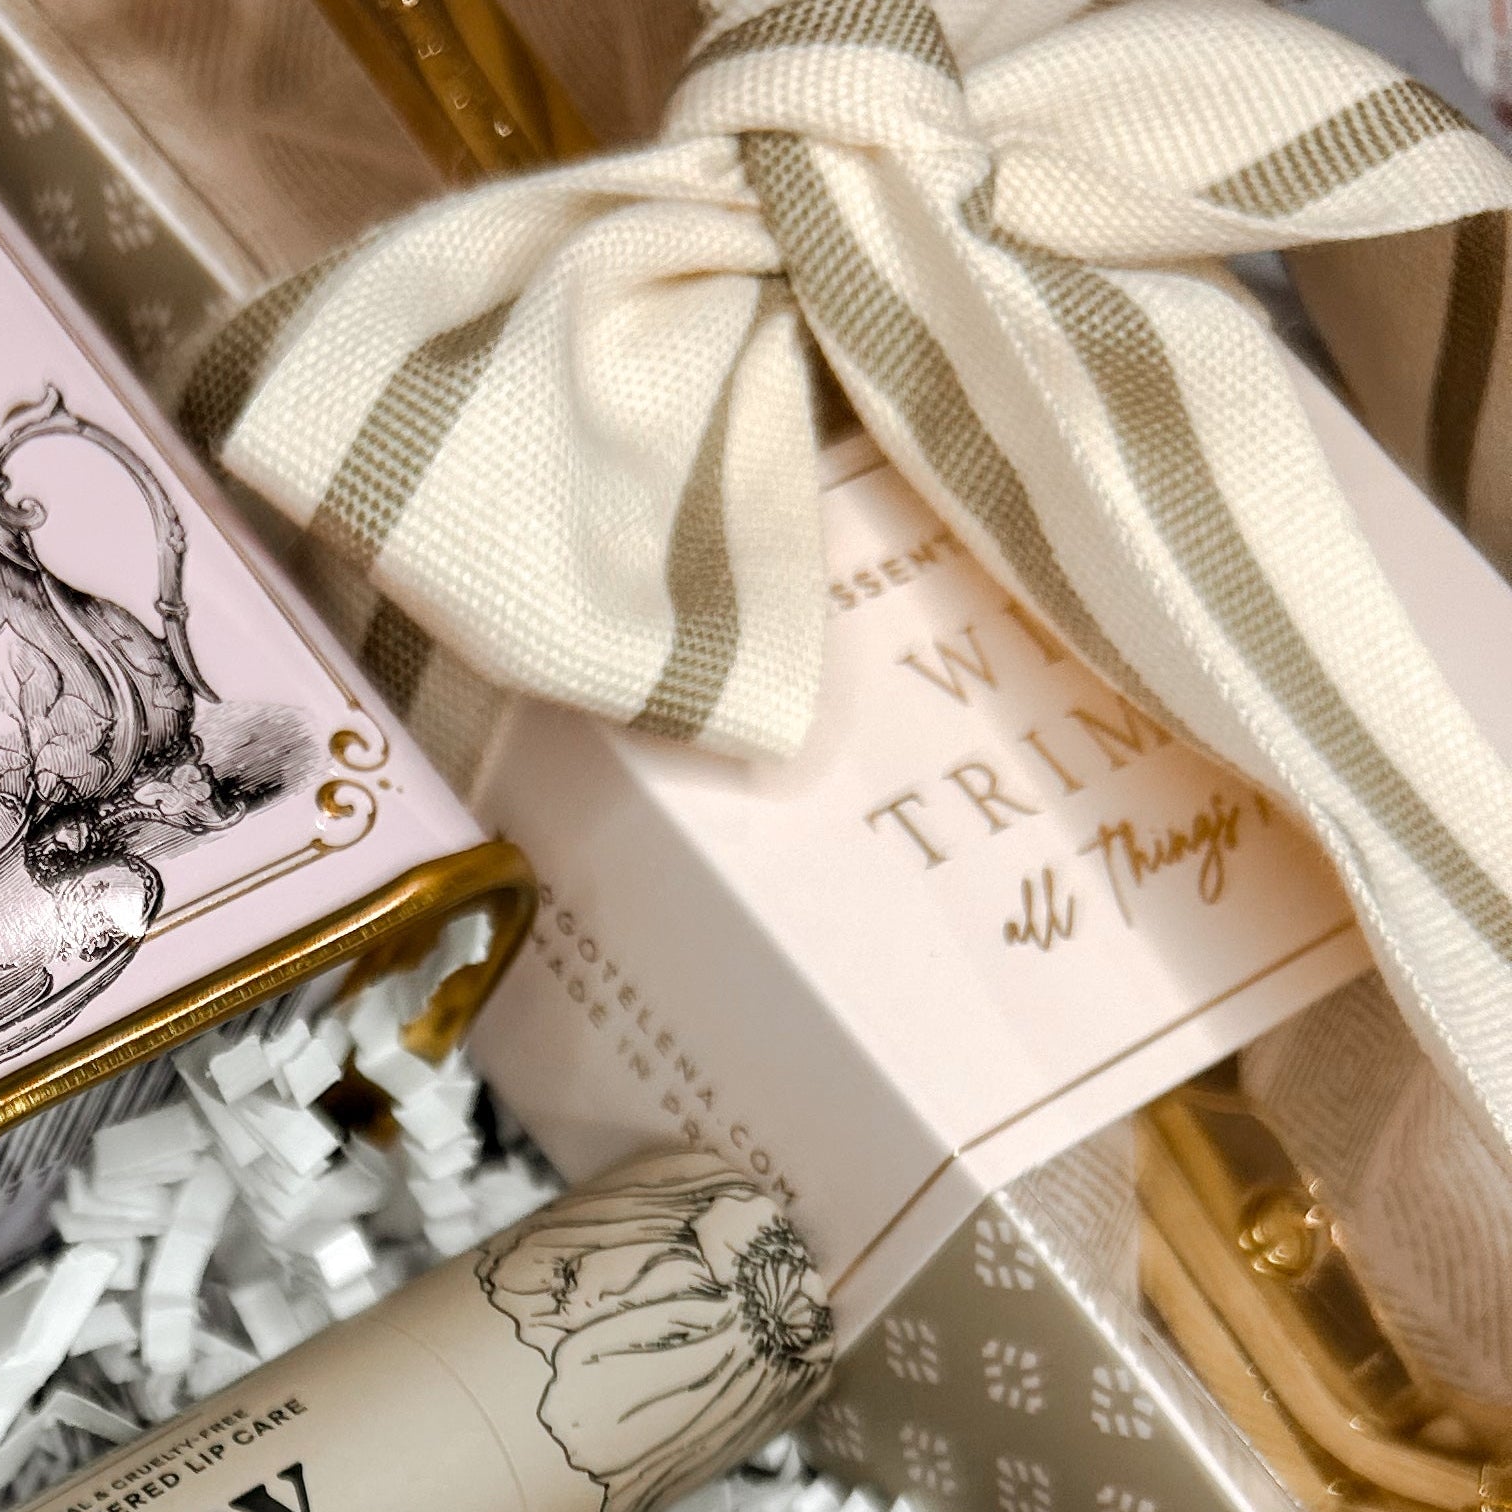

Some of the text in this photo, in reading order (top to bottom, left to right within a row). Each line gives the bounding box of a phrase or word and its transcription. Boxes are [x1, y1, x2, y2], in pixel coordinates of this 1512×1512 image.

[829, 528, 966, 611] SSENT
[898, 599, 1067, 706] WI
[864, 696, 1174, 870] TRIM
[95, 1487, 110, 1503] &
[111, 1409, 250, 1491] CRUELTY-FREE
[185, 1443, 225, 1475] LIP
[232, 1397, 308, 1446] CARE
